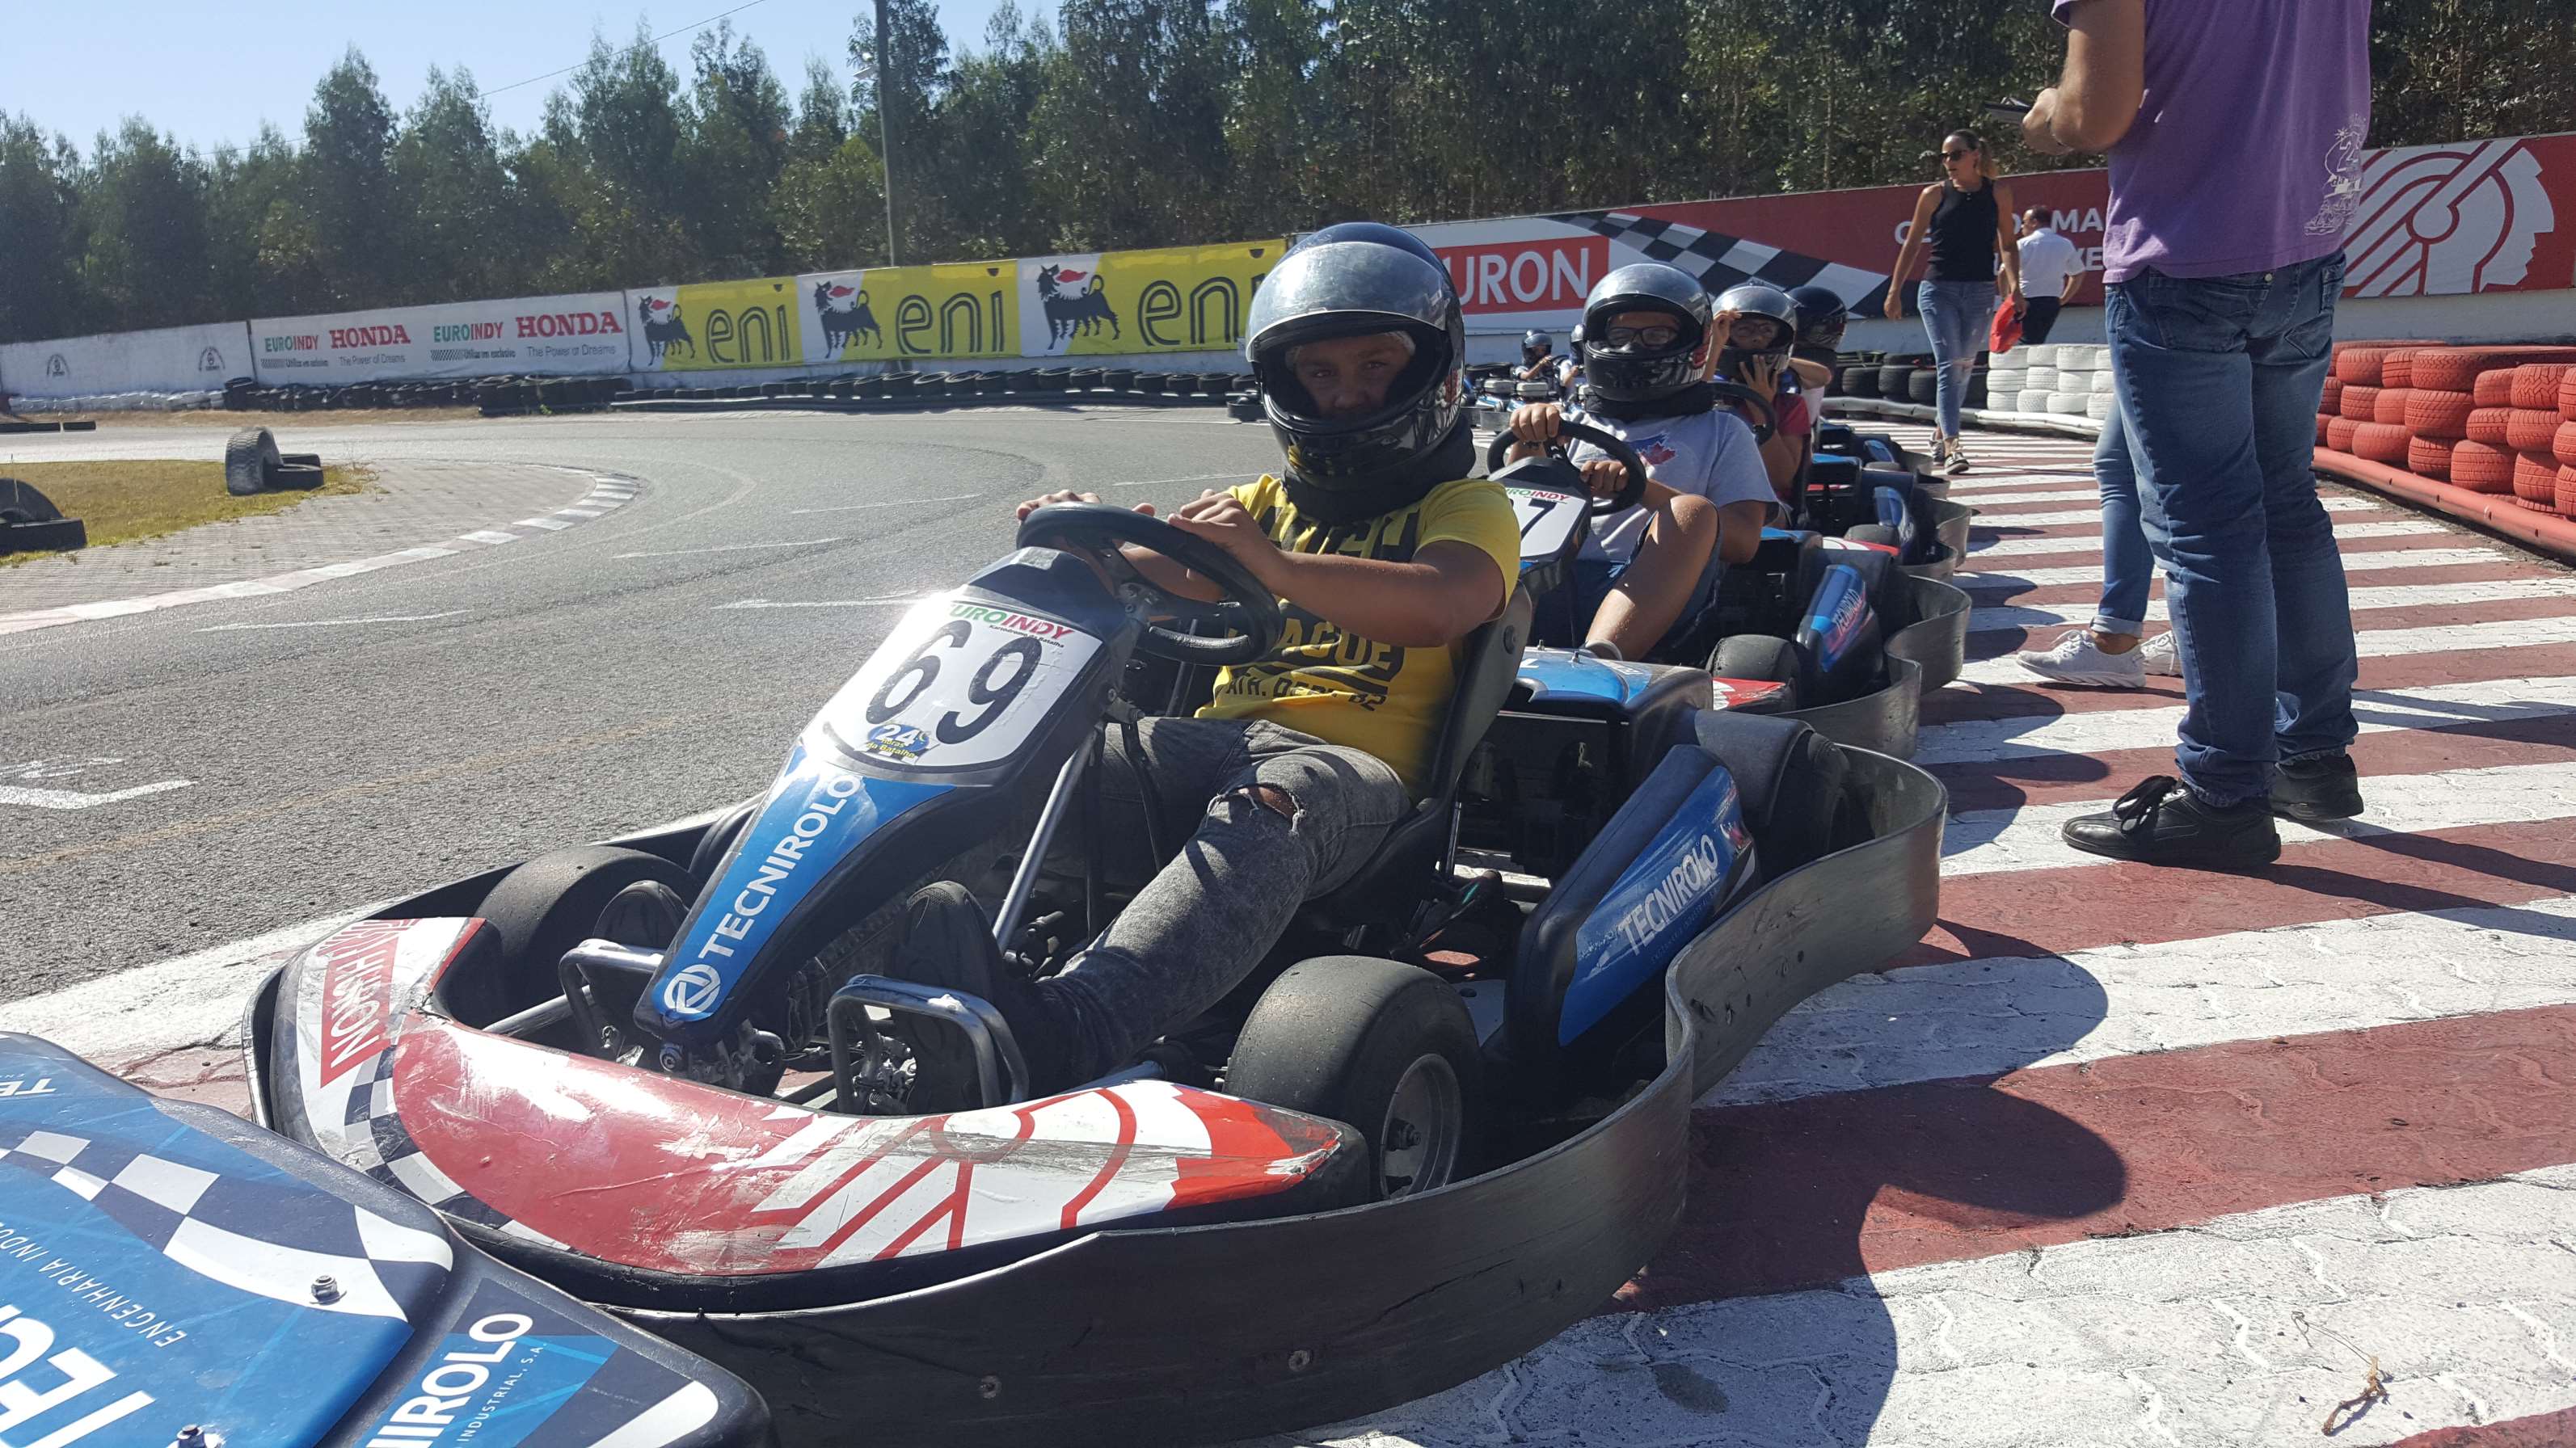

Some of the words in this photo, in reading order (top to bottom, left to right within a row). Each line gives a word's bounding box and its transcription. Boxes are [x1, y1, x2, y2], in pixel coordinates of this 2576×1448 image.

[1443, 247, 1589, 305] URON
[516, 312, 622, 338] HONDA
[706, 284, 790, 363] eni
[895, 267, 1006, 355] eni
[264, 335, 319, 352] EUROINDY
[329, 324, 411, 349] HONDA
[433, 322, 504, 343] EUROINDY
[527, 346, 543, 357] The
[546, 345, 570, 356] Power
[572, 344, 580, 356] of
[581, 343, 616, 356] Dreams
[339, 356, 352, 366] The
[1510, 498, 1558, 540] 7
[948, 604, 1076, 639] UROINDY
[1276, 617, 1391, 670] AGUE
[864, 620, 1043, 744] 69
[875, 724, 922, 747] 24
[879, 744, 916, 759] Batalha
[698, 774, 860, 958] TECNIROLO
[1618, 835, 1718, 956] TECNIROLO
[0, 1223, 49, 1262] INDU
[39, 1258, 188, 1347] ENGENHARIA
[365, 1313, 533, 1448] IROLO
